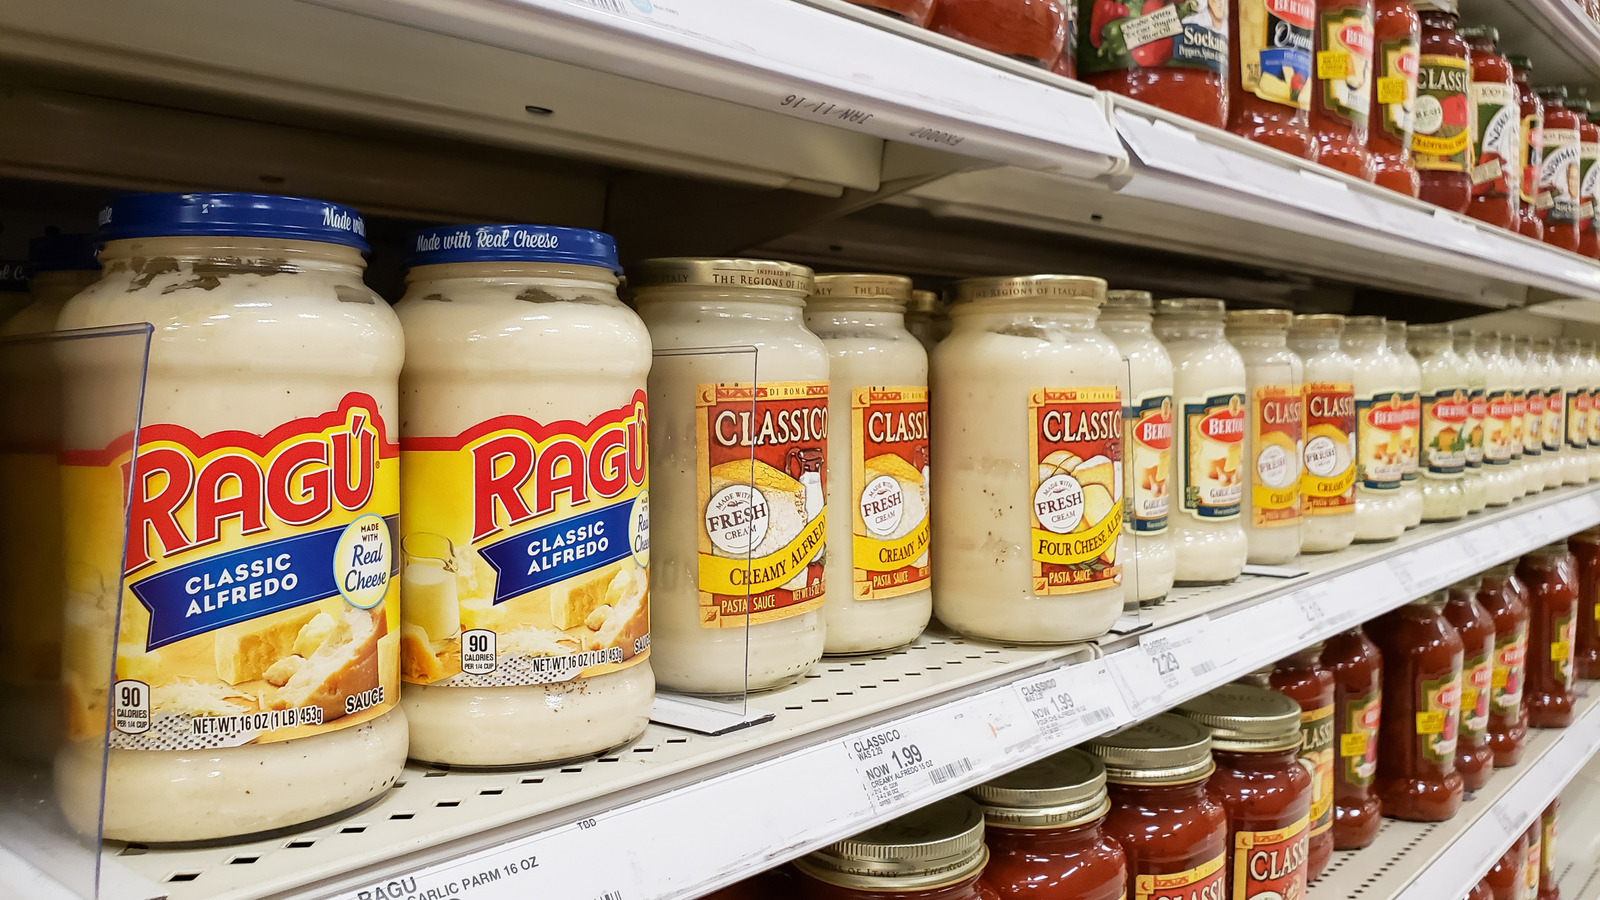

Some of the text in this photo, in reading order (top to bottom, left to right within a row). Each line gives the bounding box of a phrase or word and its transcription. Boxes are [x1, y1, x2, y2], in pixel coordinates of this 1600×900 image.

[323, 207, 366, 237] Made wit
[416, 229, 559, 252] Made with Real Cheese
[713, 274, 796, 288] THE REGIONS OF
[990, 286, 1034, 297] REGIONS
[1036, 286, 1051, 296] OF
[1052, 286, 1078, 297] ITALY
[769, 387, 806, 397] DI ROMA
[715, 405, 829, 447] CLASSICO
[470, 406, 647, 545] RAGÚ
[120, 414, 377, 579] RAGÚ
[868, 483, 882, 498] MADE
[1043, 480, 1073, 497] MADE WITH
[715, 491, 755, 510] MADE WITH
[863, 491, 902, 518] FRESH
[1036, 491, 1083, 516] FRESH
[707, 502, 767, 533] FRESH
[875, 510, 896, 524] CREAM
[1051, 510, 1076, 523] CREAM
[360, 522, 379, 534] MADE
[361, 533, 379, 544] WITH
[527, 520, 605, 557] CLASSIC
[724, 524, 758, 542] CREAM
[879, 540, 916, 564] CREAMY
[1038, 531, 1106, 556] FOUR CHEESE
[351, 543, 384, 568] Real
[527, 536, 609, 576] ALFREDO
[184, 553, 292, 596] CLASSIC
[344, 569, 387, 593] Cheese
[729, 559, 788, 586] CREAMY
[873, 571, 909, 588] PASTA SAUCE
[1048, 569, 1072, 585] PASTA
[1073, 568, 1091, 581] SAUCE
[184, 572, 299, 619] ALFREDO
[721, 594, 776, 614] PASTA SAUCE
[468, 635, 488, 653] 90
[464, 652, 494, 662] CALORIES
[464, 662, 475, 670] PER
[484, 661, 494, 670] CUP
[533, 658, 551, 672] NET
[551, 656, 567, 670] WT
[568, 654, 577, 668] 16
[578, 653, 589, 667] OZ
[597, 650, 608, 664] LB)
[1152, 652, 1180, 676] 2.29
[121, 687, 141, 708] 90
[1020, 678, 1057, 696] CLASSICO
[345, 686, 385, 713] SAUCE
[1031, 692, 1075, 720] NOW 1.99
[116, 707, 147, 720] CALORIES
[117, 720, 127, 729] PER
[136, 719, 147, 728] CUP
[193, 706, 324, 736] NET WT 16 OZ (1 LB) 453g
[853, 729, 901, 753] CLASSICO
[857, 746, 883, 761] WAS 2.29
[865, 743, 923, 781] NOW 1.99
[870, 776, 894, 789] CREAMY
[894, 765, 919, 781] ALFREDO
[576, 818, 597, 830] TBD
[461, 868, 502, 891] PARM
[504, 862, 519, 877] 16
[519, 856, 539, 871] OZ
[865, 868, 900, 878] ITALY
